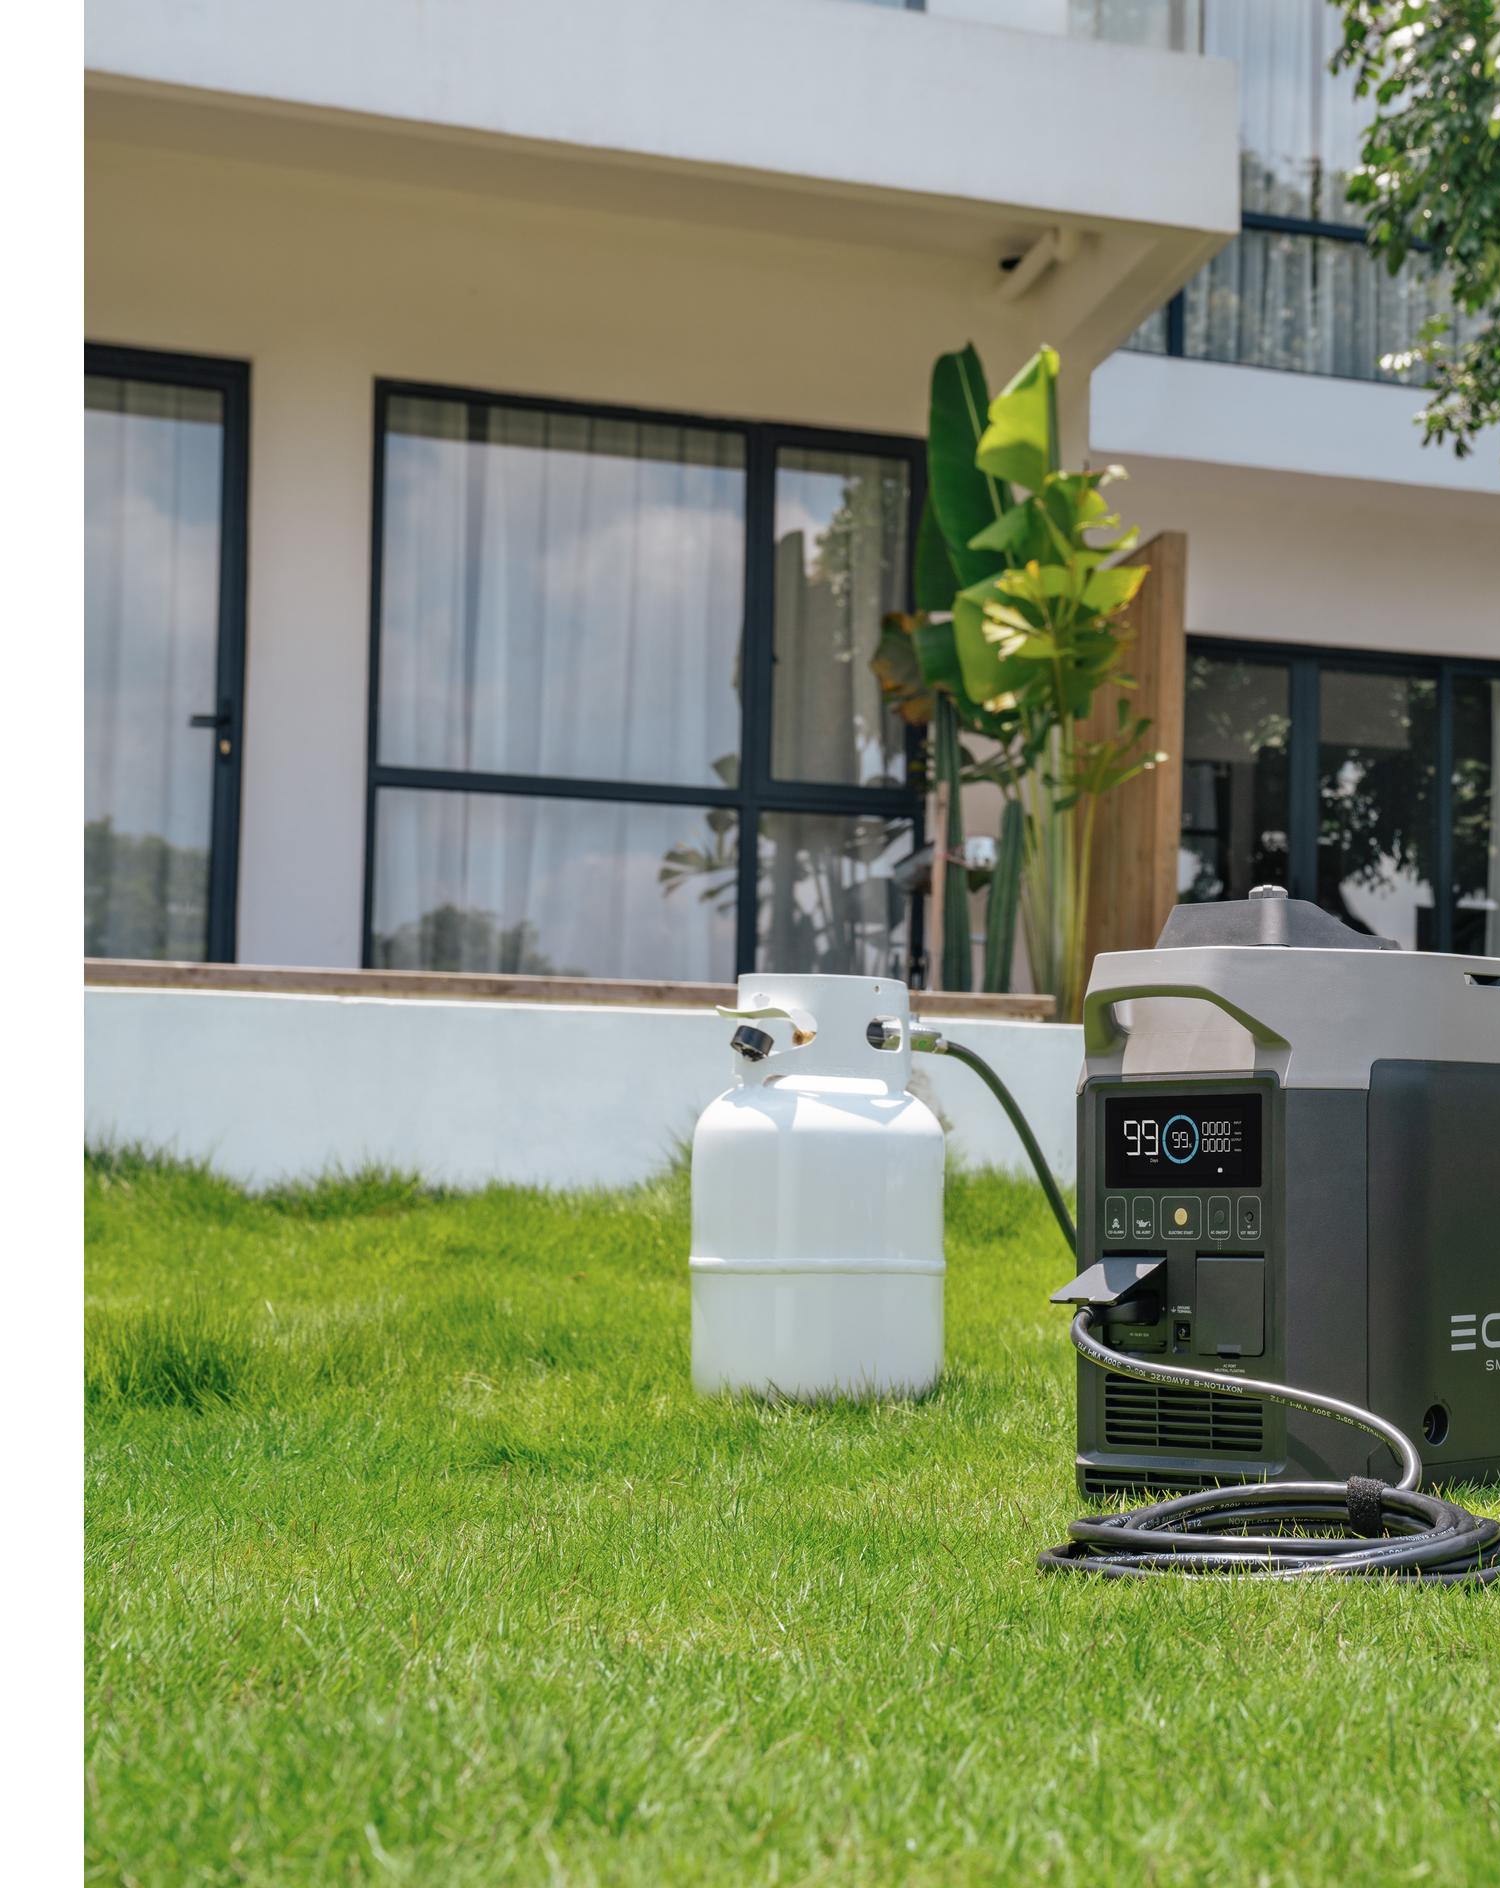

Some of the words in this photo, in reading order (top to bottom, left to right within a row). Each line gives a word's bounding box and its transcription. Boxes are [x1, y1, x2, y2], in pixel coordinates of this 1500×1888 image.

[1202, 1122, 1230, 1136] 0000
[1124, 1120, 1158, 1156] 99
[1202, 1138, 1230, 1152] 0000
